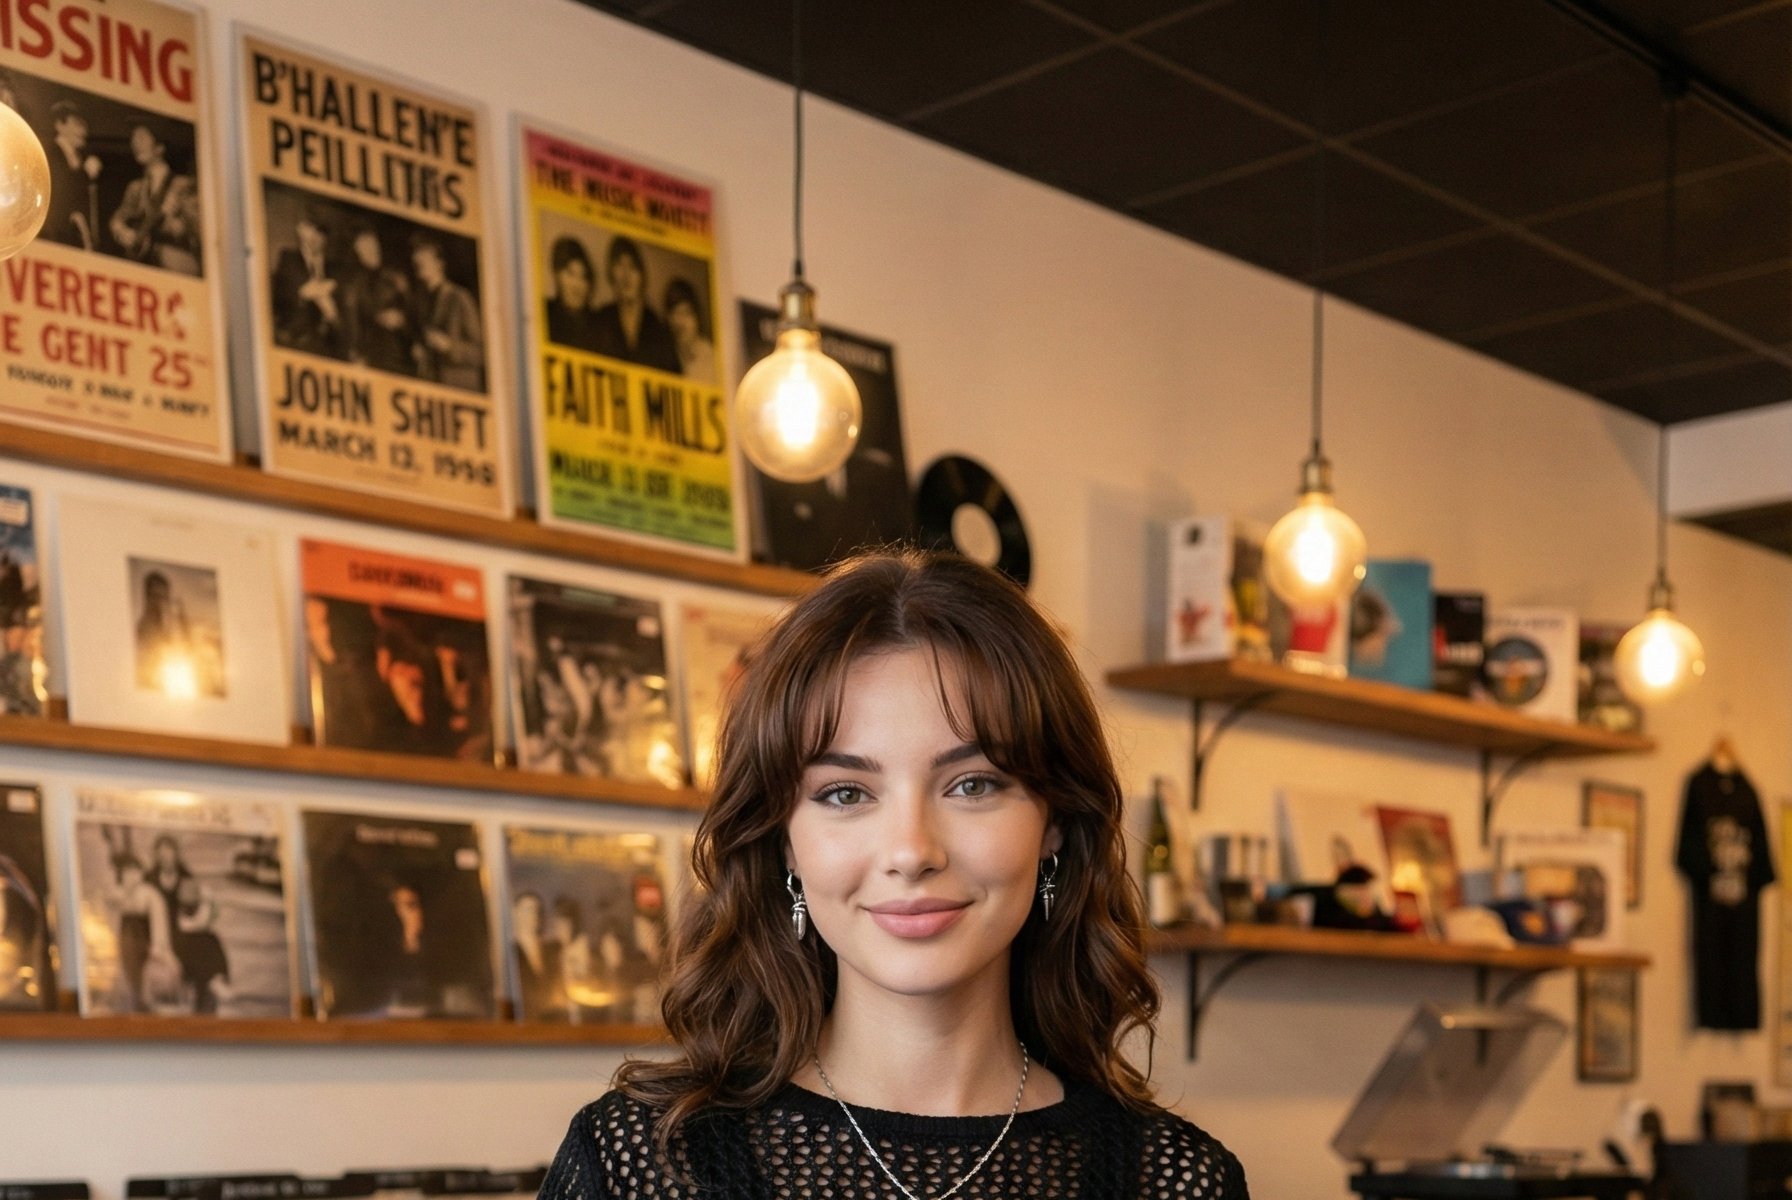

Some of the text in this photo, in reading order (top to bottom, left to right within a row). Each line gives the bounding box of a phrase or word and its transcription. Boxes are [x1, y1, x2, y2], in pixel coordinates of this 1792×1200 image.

[278, 364, 373, 425] JOHN
[391, 389, 487, 450] SHIFT
[279, 419, 376, 464] MARCH
[545, 354, 727, 456] FAITH MILLS
